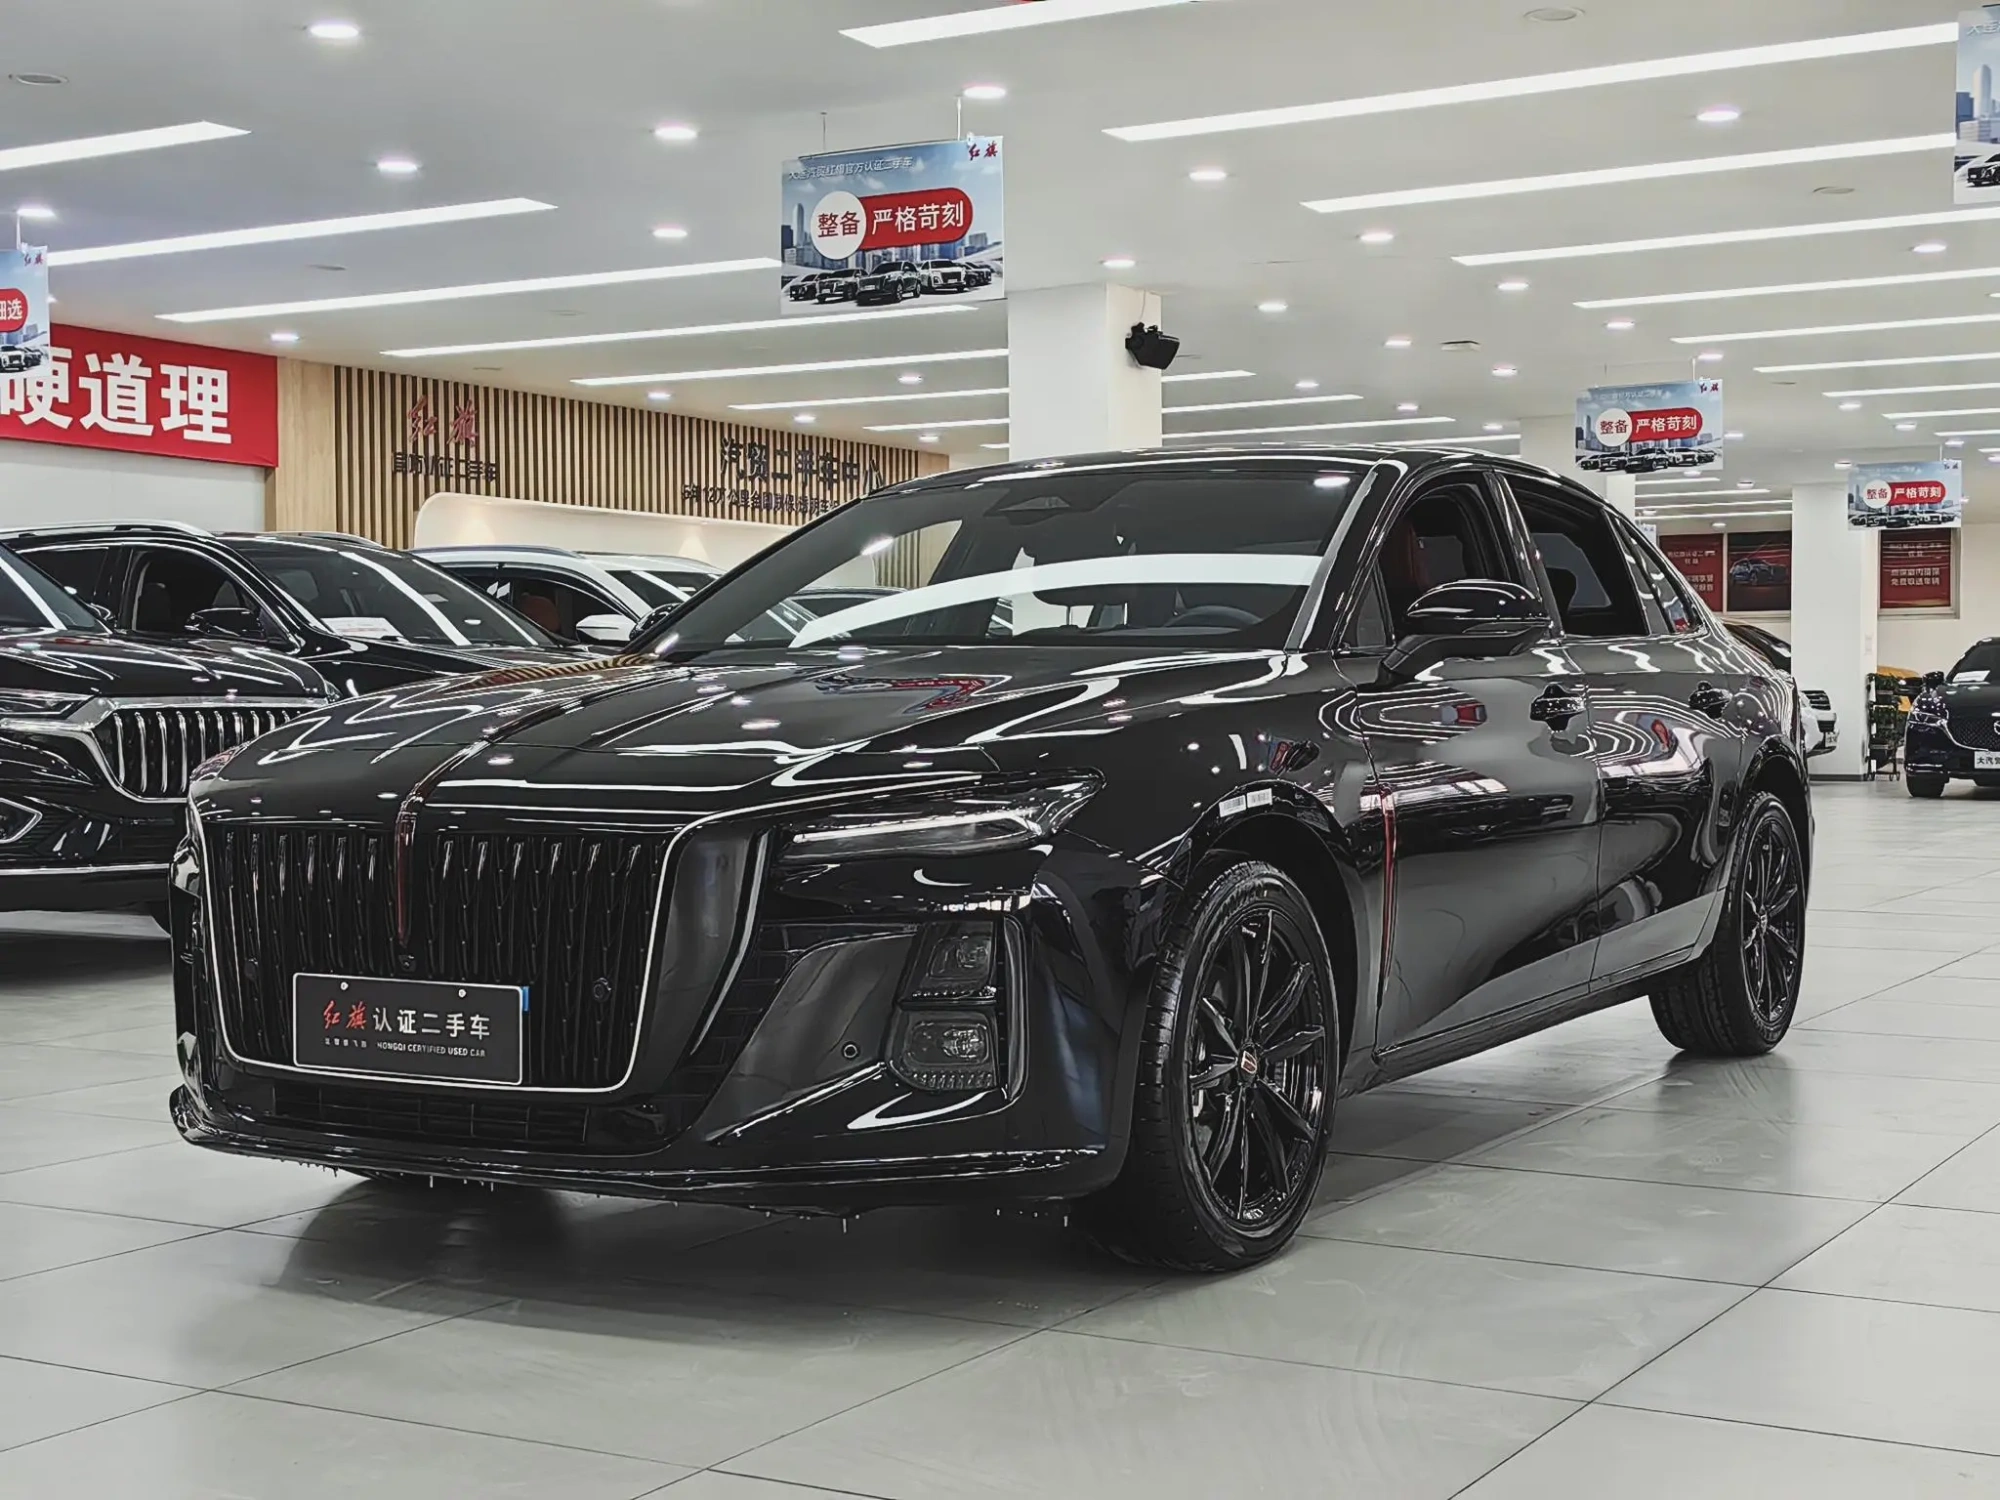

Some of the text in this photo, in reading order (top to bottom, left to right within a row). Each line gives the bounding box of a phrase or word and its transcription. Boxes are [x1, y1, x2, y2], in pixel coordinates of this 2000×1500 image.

[968, 140, 998, 161] 红旗
[817, 200, 964, 238] 整备 严格苛刻
[1600, 414, 1697, 435] 整备 严格苛刻
[377, 1041, 406, 1051] HONGQI
[407, 1043, 446, 1055] CERTIFIED
[447, 1046, 468, 1057] USED
[470, 1048, 486, 1057] CAR
